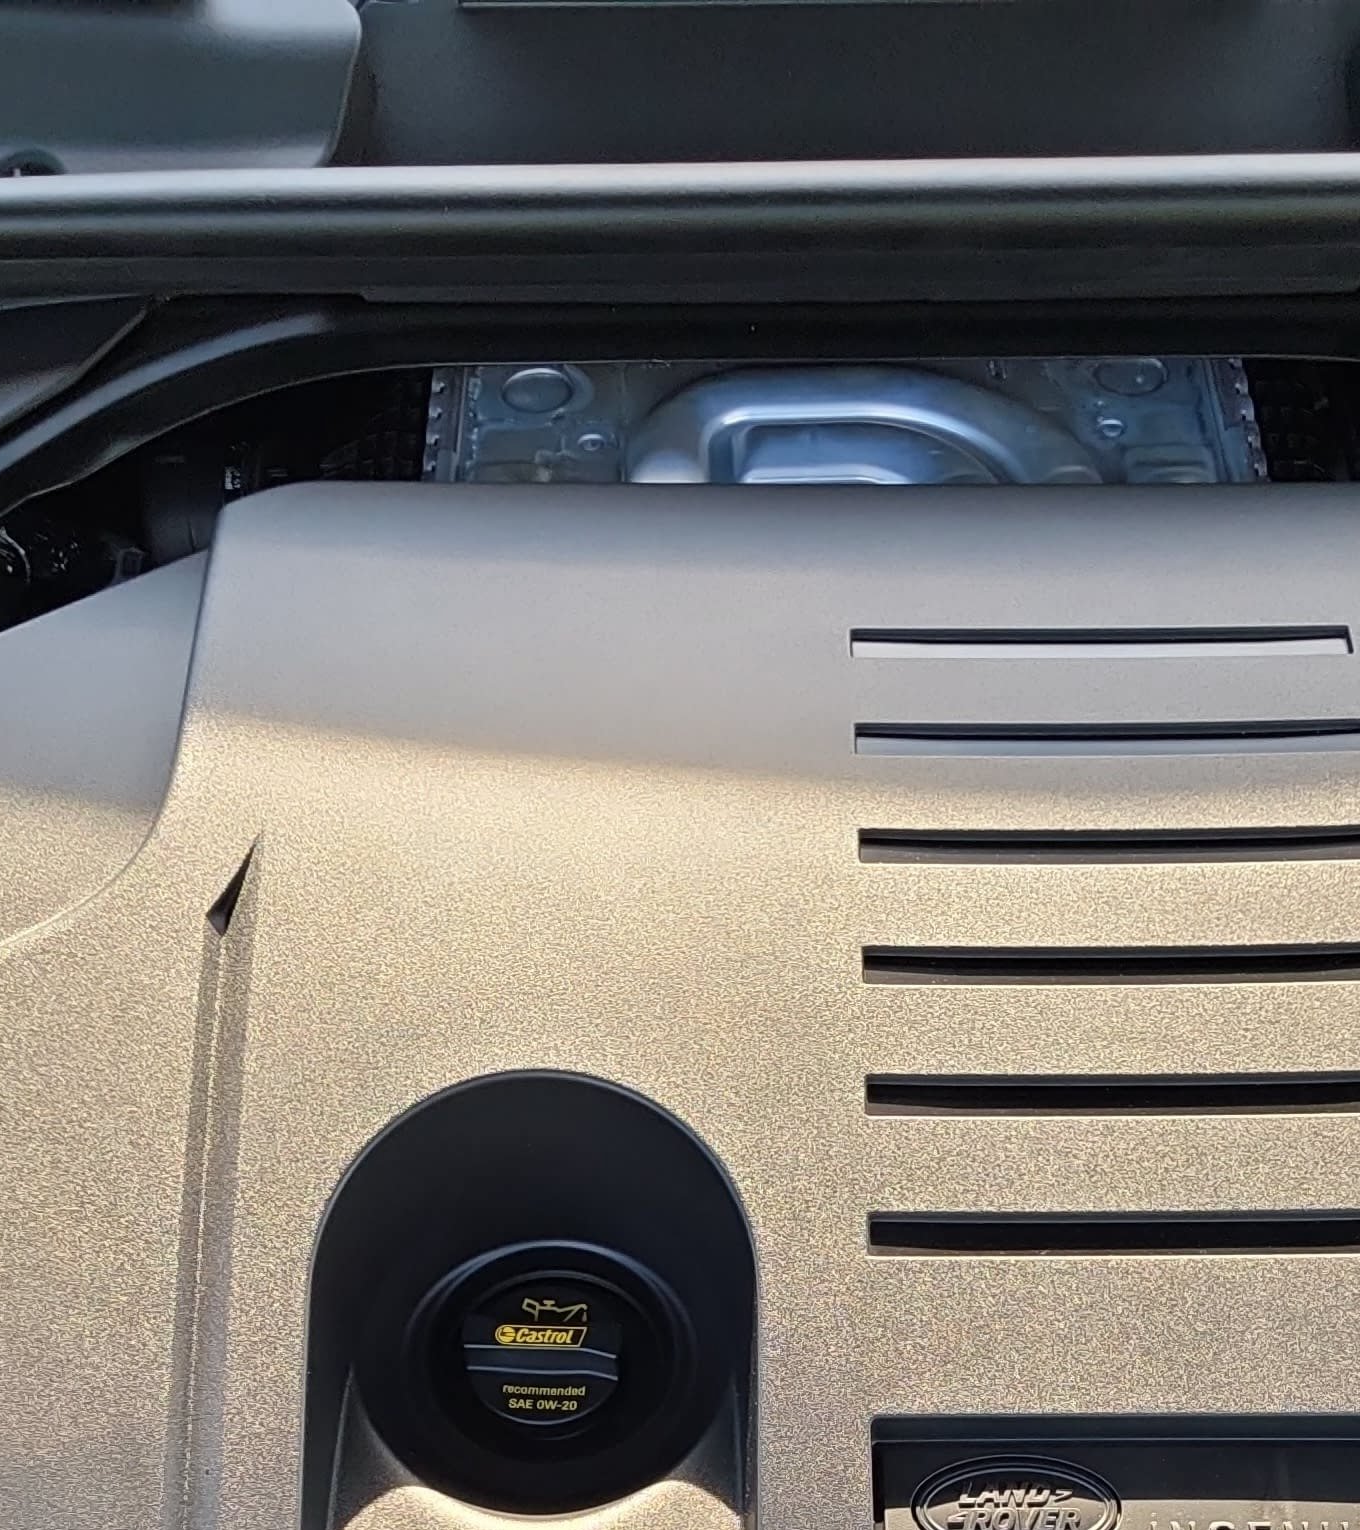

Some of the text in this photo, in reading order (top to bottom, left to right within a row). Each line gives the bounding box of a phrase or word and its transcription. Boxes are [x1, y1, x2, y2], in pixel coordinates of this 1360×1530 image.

[515, 1327, 573, 1344] Castrol
[502, 1384, 586, 1397] recommended
[508, 1398, 578, 1411] SAE 0W-20
[958, 1481, 1051, 1508] LAND
